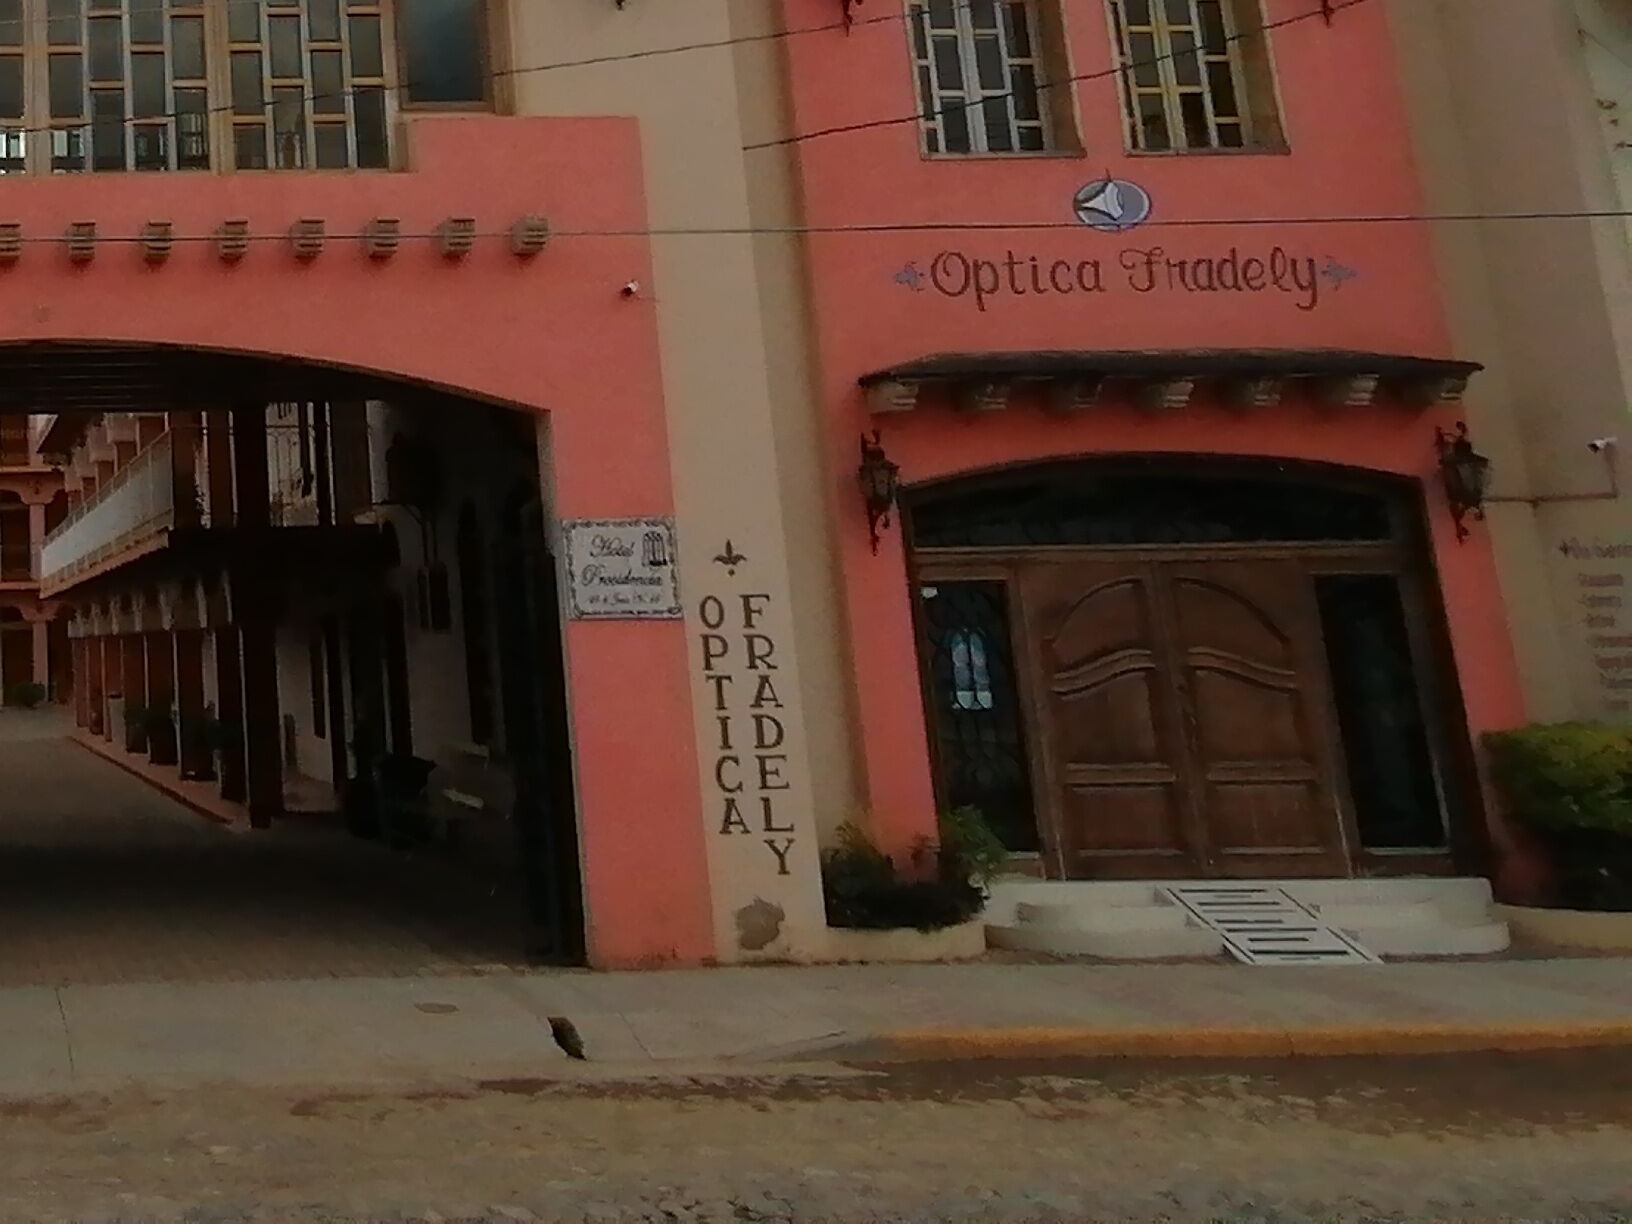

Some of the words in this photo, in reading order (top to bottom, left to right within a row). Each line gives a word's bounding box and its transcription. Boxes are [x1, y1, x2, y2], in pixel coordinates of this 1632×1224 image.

[930, 250, 1106, 312] Optica
[1119, 246, 1319, 311] Fradely
[699, 595, 751, 834] OPTICA
[739, 594, 795, 875] FRADELY
